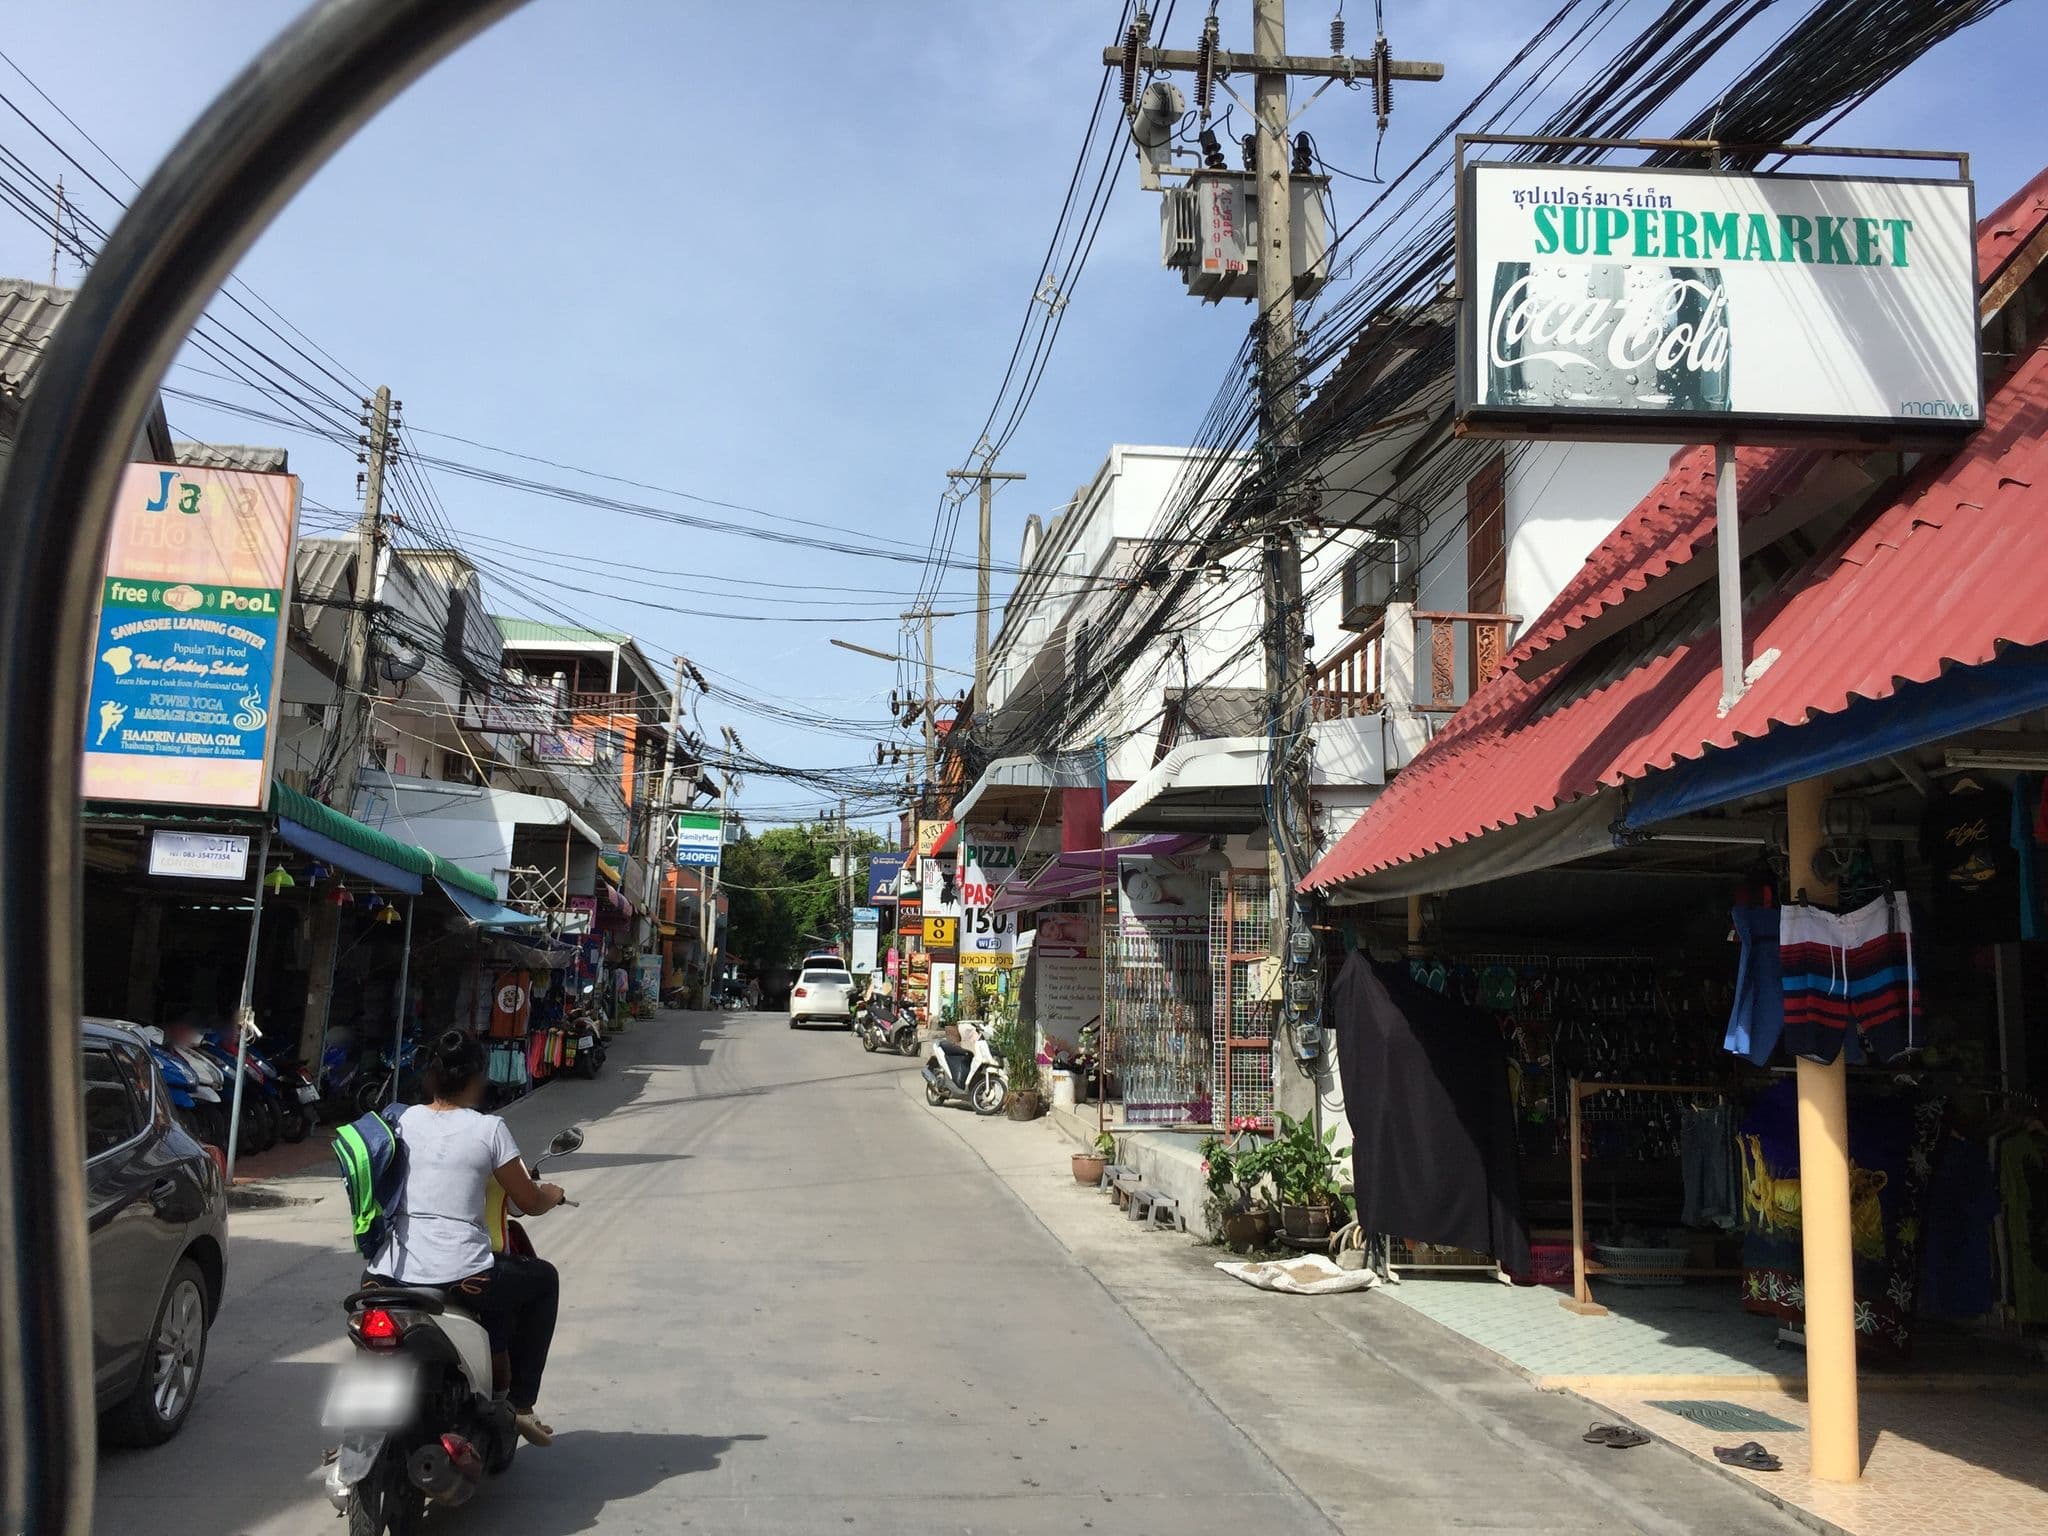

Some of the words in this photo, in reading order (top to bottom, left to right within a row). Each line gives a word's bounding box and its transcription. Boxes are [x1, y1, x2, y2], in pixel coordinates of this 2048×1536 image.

[1512, 185, 1673, 210] ซุปเปอร์มาร์เก็ต
[1533, 204, 1913, 267] SUPERMARKET
[1490, 275, 1729, 373] Coca-Cola
[111, 583, 148, 602] free
[111, 618, 172, 640] SAWASDEE
[173, 618, 226, 635] LEARNING
[227, 626, 267, 650] CENTER
[174, 643, 205, 657] Popular
[207, 645, 225, 656] Thai
[226, 645, 247, 657] Food
[134, 653, 162, 670] Thai
[162, 656, 208, 676] Cooking
[209, 660, 250, 676] School
[135, 678, 150, 686] How
[160, 679, 176, 687] Cook
[177, 679, 192, 688] from
[193, 680, 231, 690] Professional
[149, 693, 191, 707] POWER
[192, 696, 224, 711] YOGA
[134, 707, 185, 722] MASSAGE
[187, 711, 229, 725] SCHOOL
[122, 729, 176, 743] HAADRIN
[176, 732, 214, 745] ARENA
[215, 734, 241, 746] GYM
[680, 832, 719, 841] FamilyMart
[966, 845, 1016, 868] PIZZA
